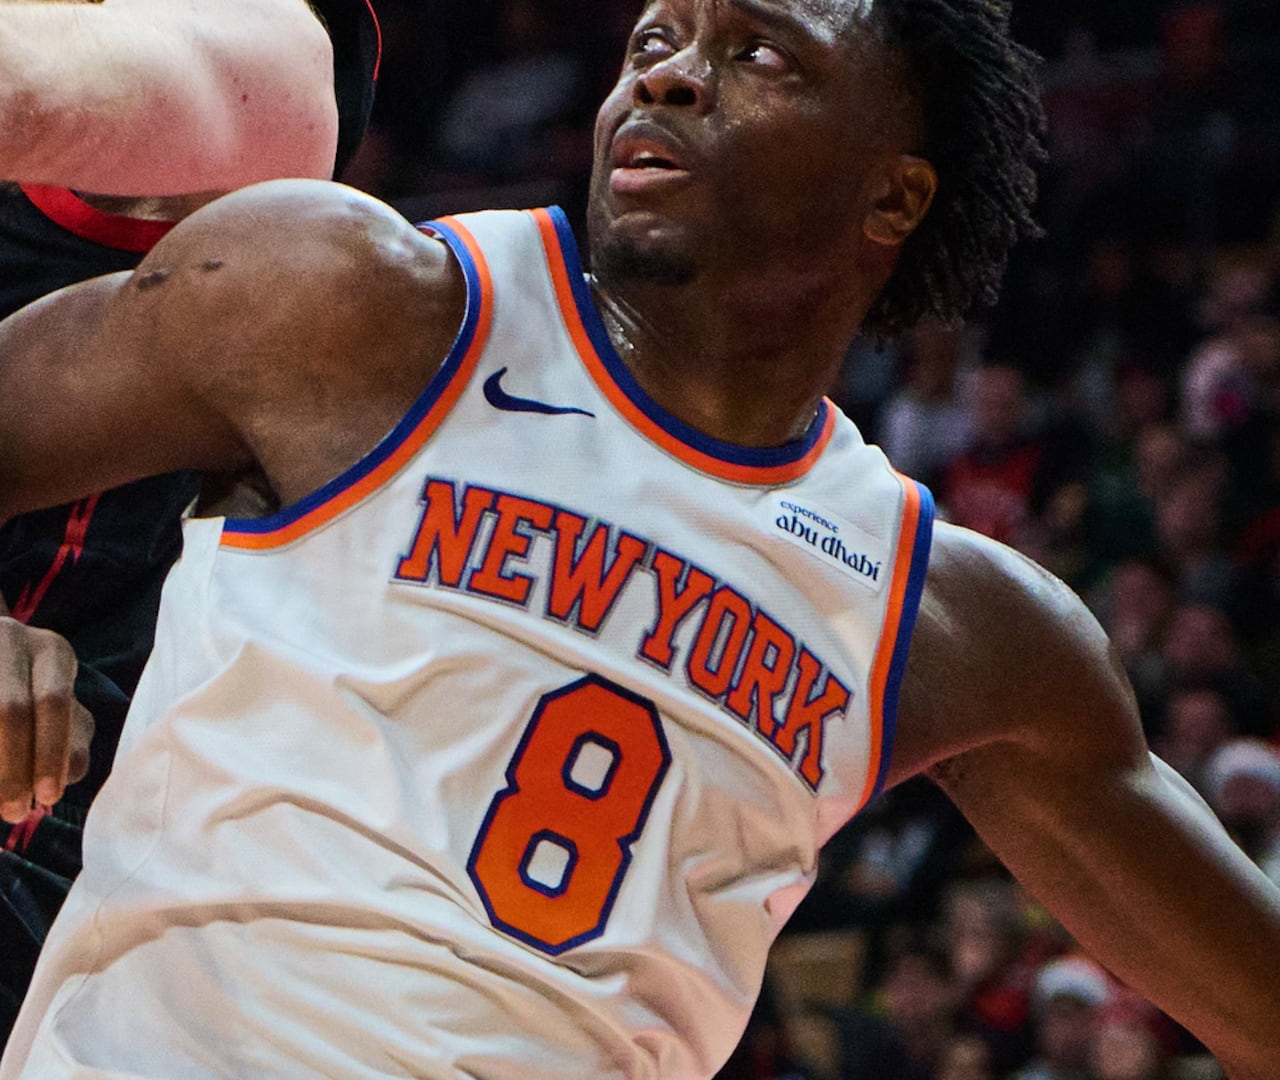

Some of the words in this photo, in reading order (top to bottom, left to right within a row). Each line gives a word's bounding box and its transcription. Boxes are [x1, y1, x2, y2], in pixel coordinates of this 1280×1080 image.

[775, 514, 818, 547] abu
[820, 534, 882, 582] dhabi
[780, 500, 840, 534] experience
[388, 475, 647, 640] NEW
[635, 541, 853, 798] YORK
[466, 672, 672, 956] 8
